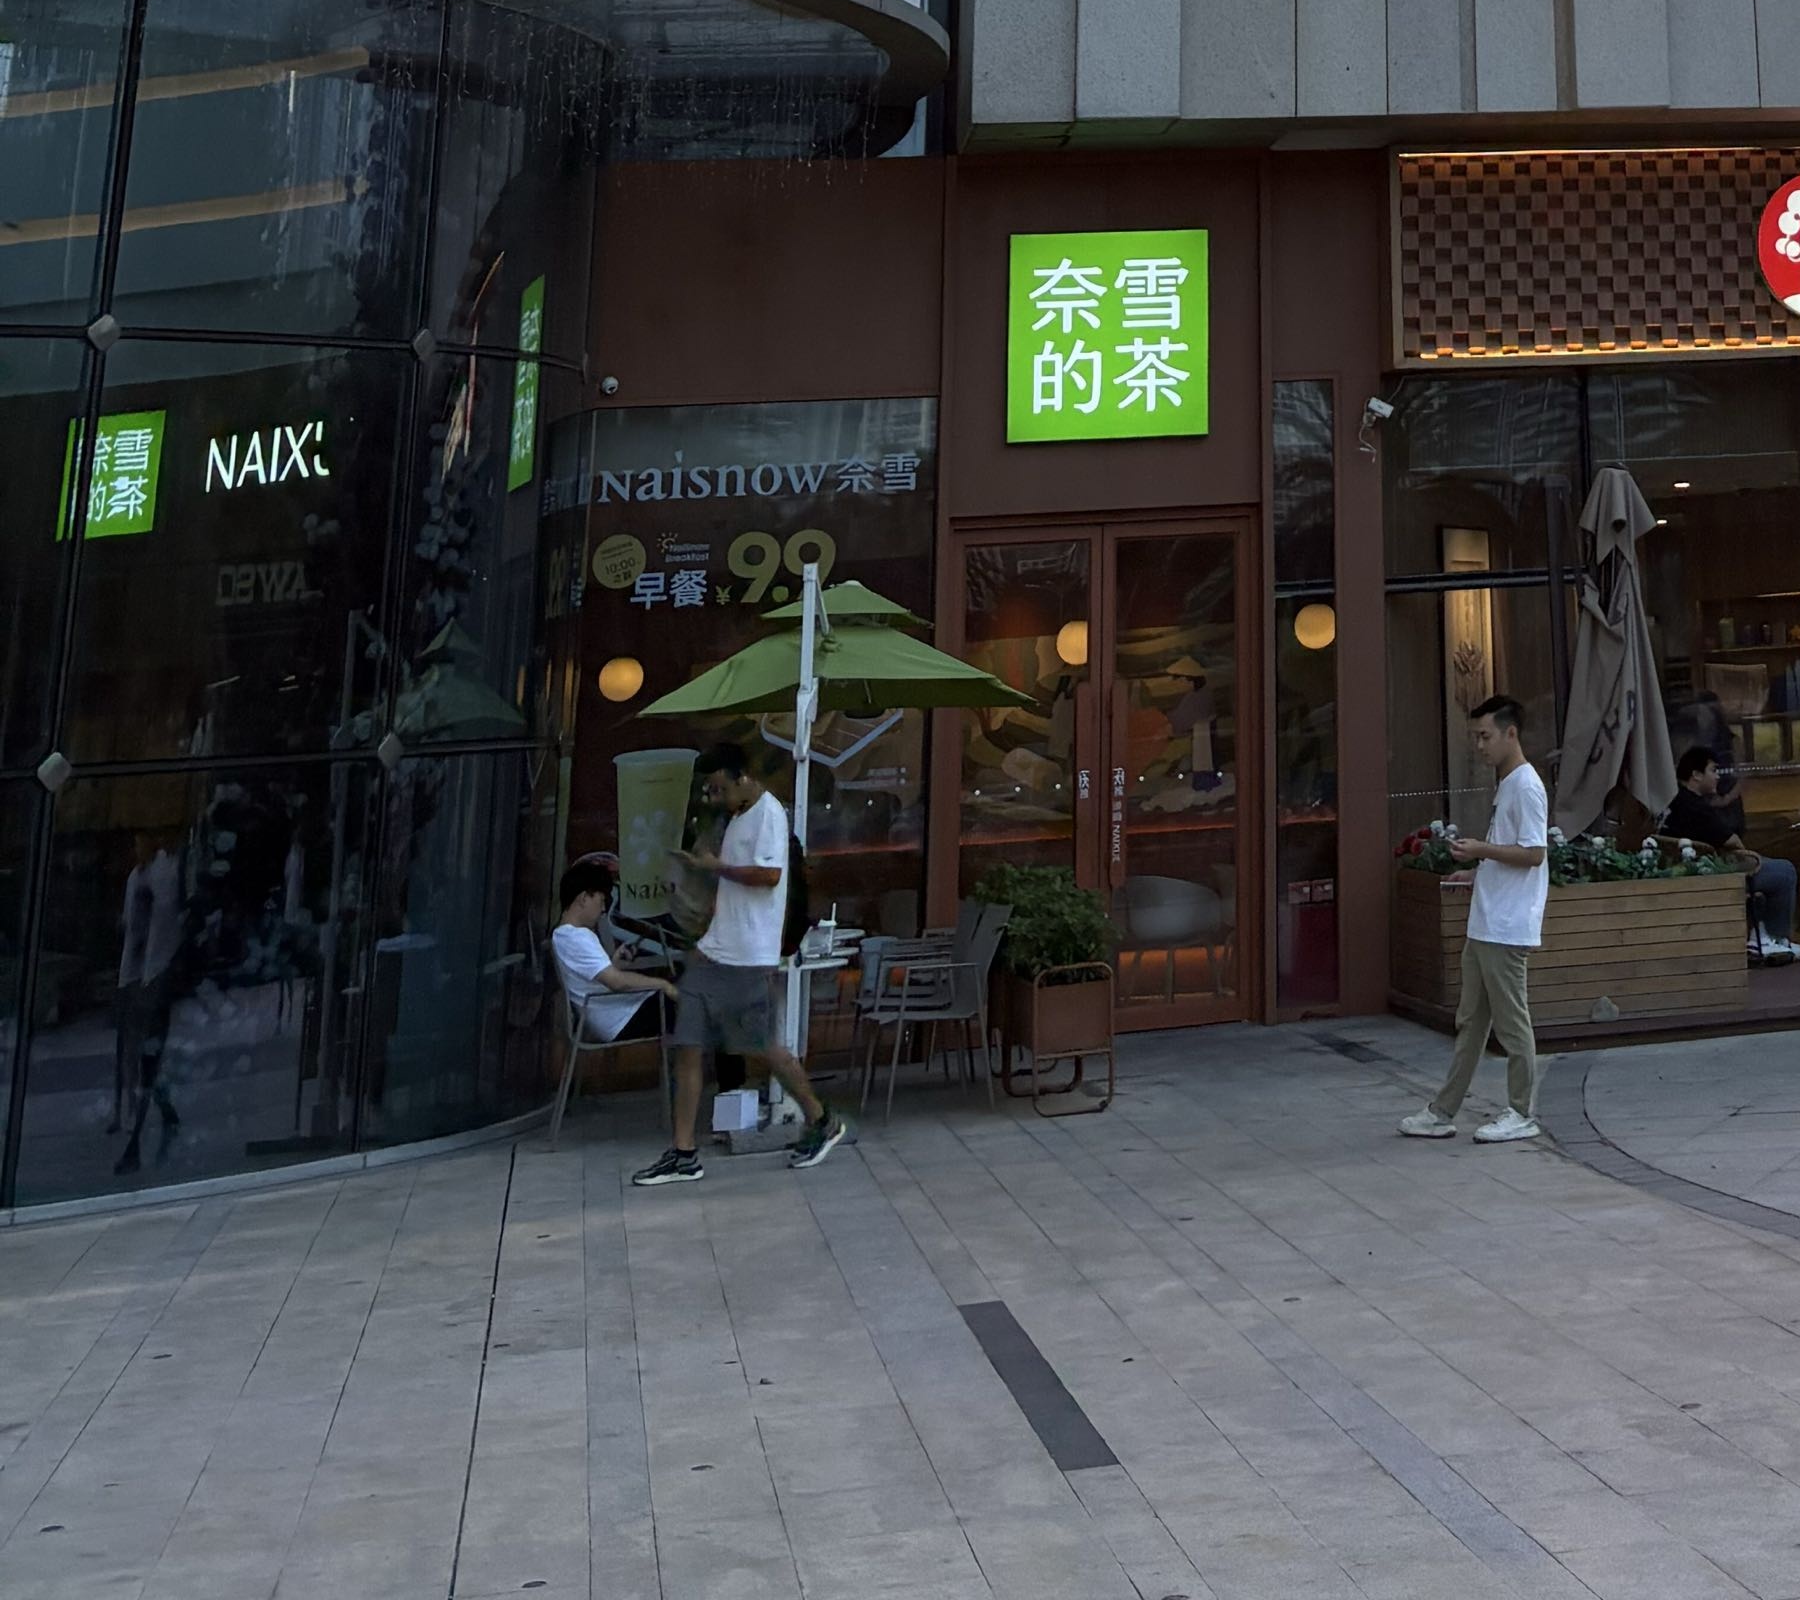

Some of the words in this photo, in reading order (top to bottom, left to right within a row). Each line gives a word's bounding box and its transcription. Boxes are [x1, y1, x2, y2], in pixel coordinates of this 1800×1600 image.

[1029, 257, 1189, 334] 奈雪
[1032, 336, 1190, 415] 的茶
[597, 450, 829, 503] Naisnow
[836, 451, 921, 494] 奈雪
[630, 569, 708, 610] 早餐
